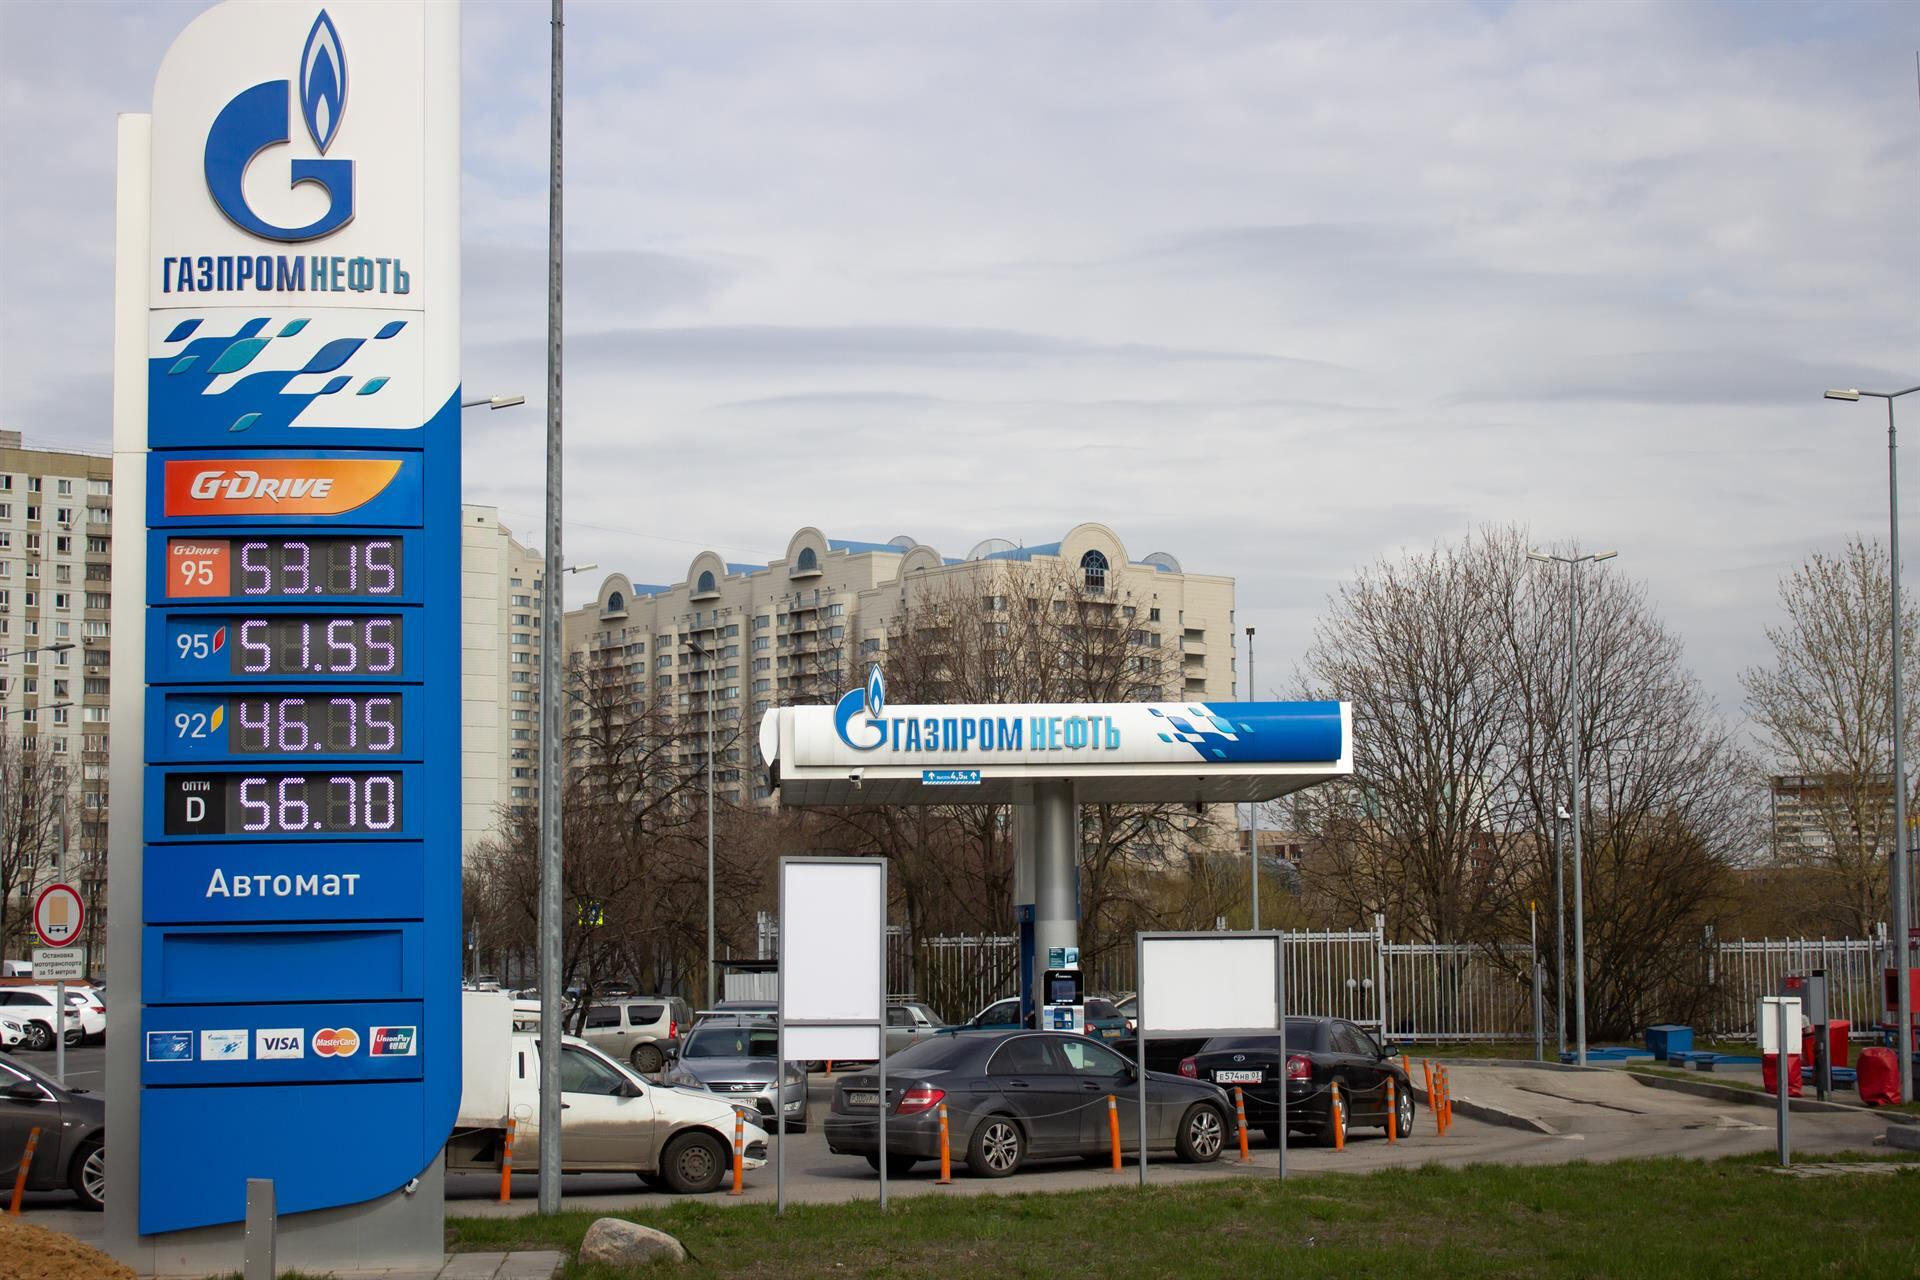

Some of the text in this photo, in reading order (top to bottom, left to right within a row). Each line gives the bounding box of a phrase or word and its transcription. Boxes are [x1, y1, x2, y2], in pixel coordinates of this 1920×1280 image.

[181, 560, 214, 586] 95
[241, 542, 395, 594] 53.15
[176, 633, 209, 660] 95
[240, 620, 395, 672] 51.55
[174, 712, 207, 739] 92
[240, 698, 395, 751] 46.75
[186, 796, 206, 823] D
[240, 777, 395, 830] 56.70
[205, 868, 361, 898] Автомат
[262, 1037, 300, 1050] VISA
[316, 1038, 357, 1047] MasterCard
[376, 1034, 412, 1046] UnionPay
